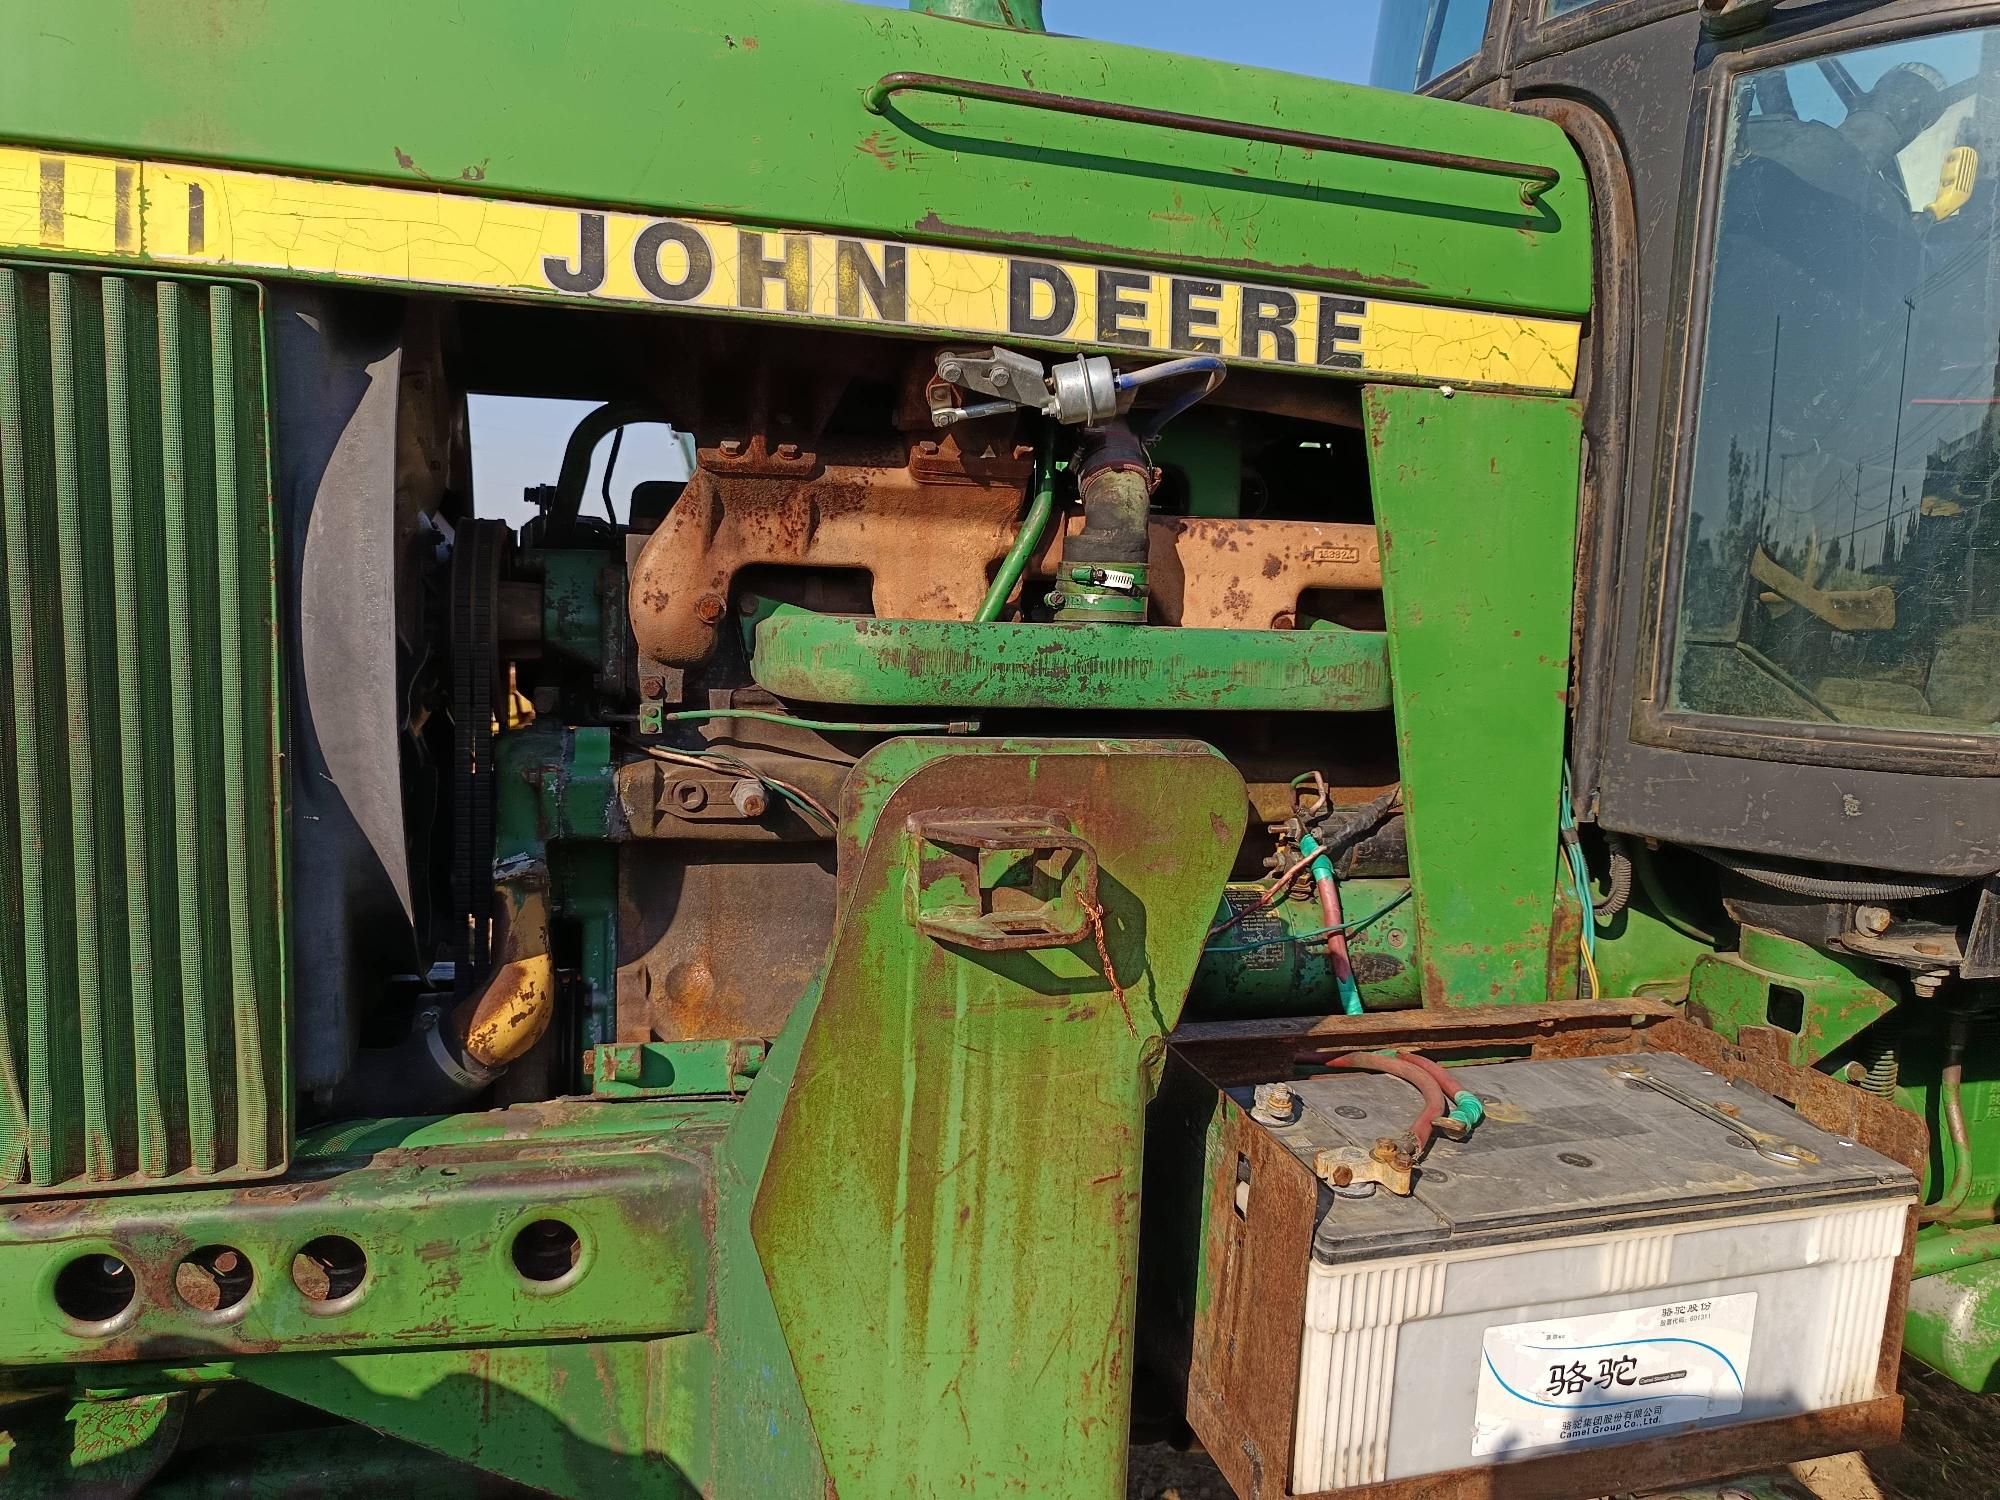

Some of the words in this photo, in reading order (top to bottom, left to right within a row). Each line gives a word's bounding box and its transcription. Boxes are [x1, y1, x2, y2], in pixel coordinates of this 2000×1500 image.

[543, 212, 906, 323] JOHN
[1009, 258, 1366, 370] DEERE
[1661, 1302, 1712, 1317] 骆驼股份
[1546, 1354, 1638, 1396] 骆驼
[1562, 1405, 1662, 1431] 骆驼集团股份有限公司
[1560, 1427, 1590, 1439] Camel
[1592, 1424, 1622, 1434] Group
